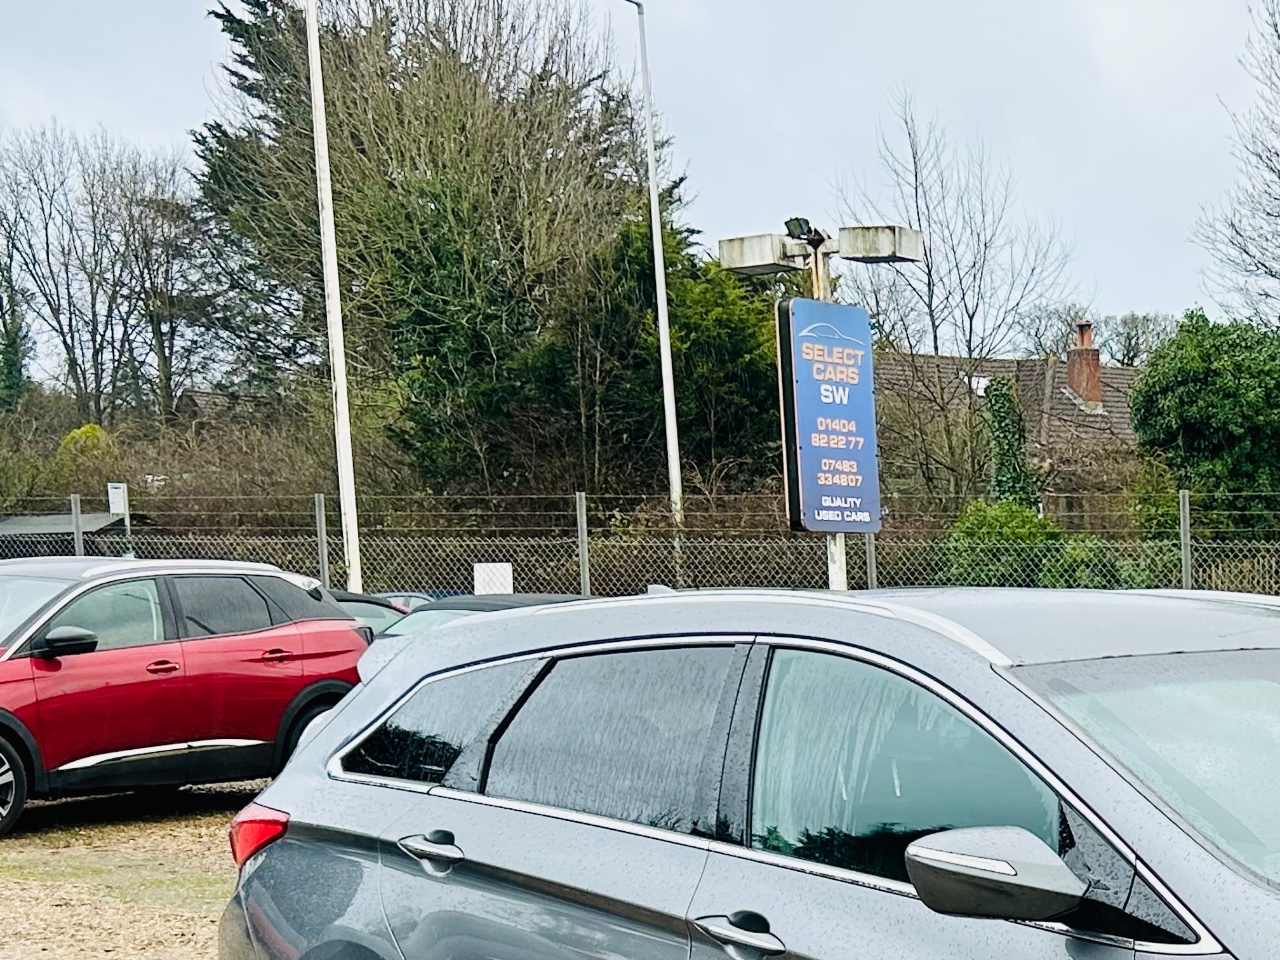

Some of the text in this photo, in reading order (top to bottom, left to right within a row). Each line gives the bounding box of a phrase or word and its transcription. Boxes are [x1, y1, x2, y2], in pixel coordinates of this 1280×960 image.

[802, 342, 865, 366] SELECT
[812, 363, 859, 385] CARS
[820, 384, 849, 405] SW
[817, 417, 856, 433] 01404
[821, 458, 858, 472] 07483
[817, 472, 863, 487] 334807
[821, 496, 861, 508] QUALITY
[814, 509, 870, 523] USED CARS
